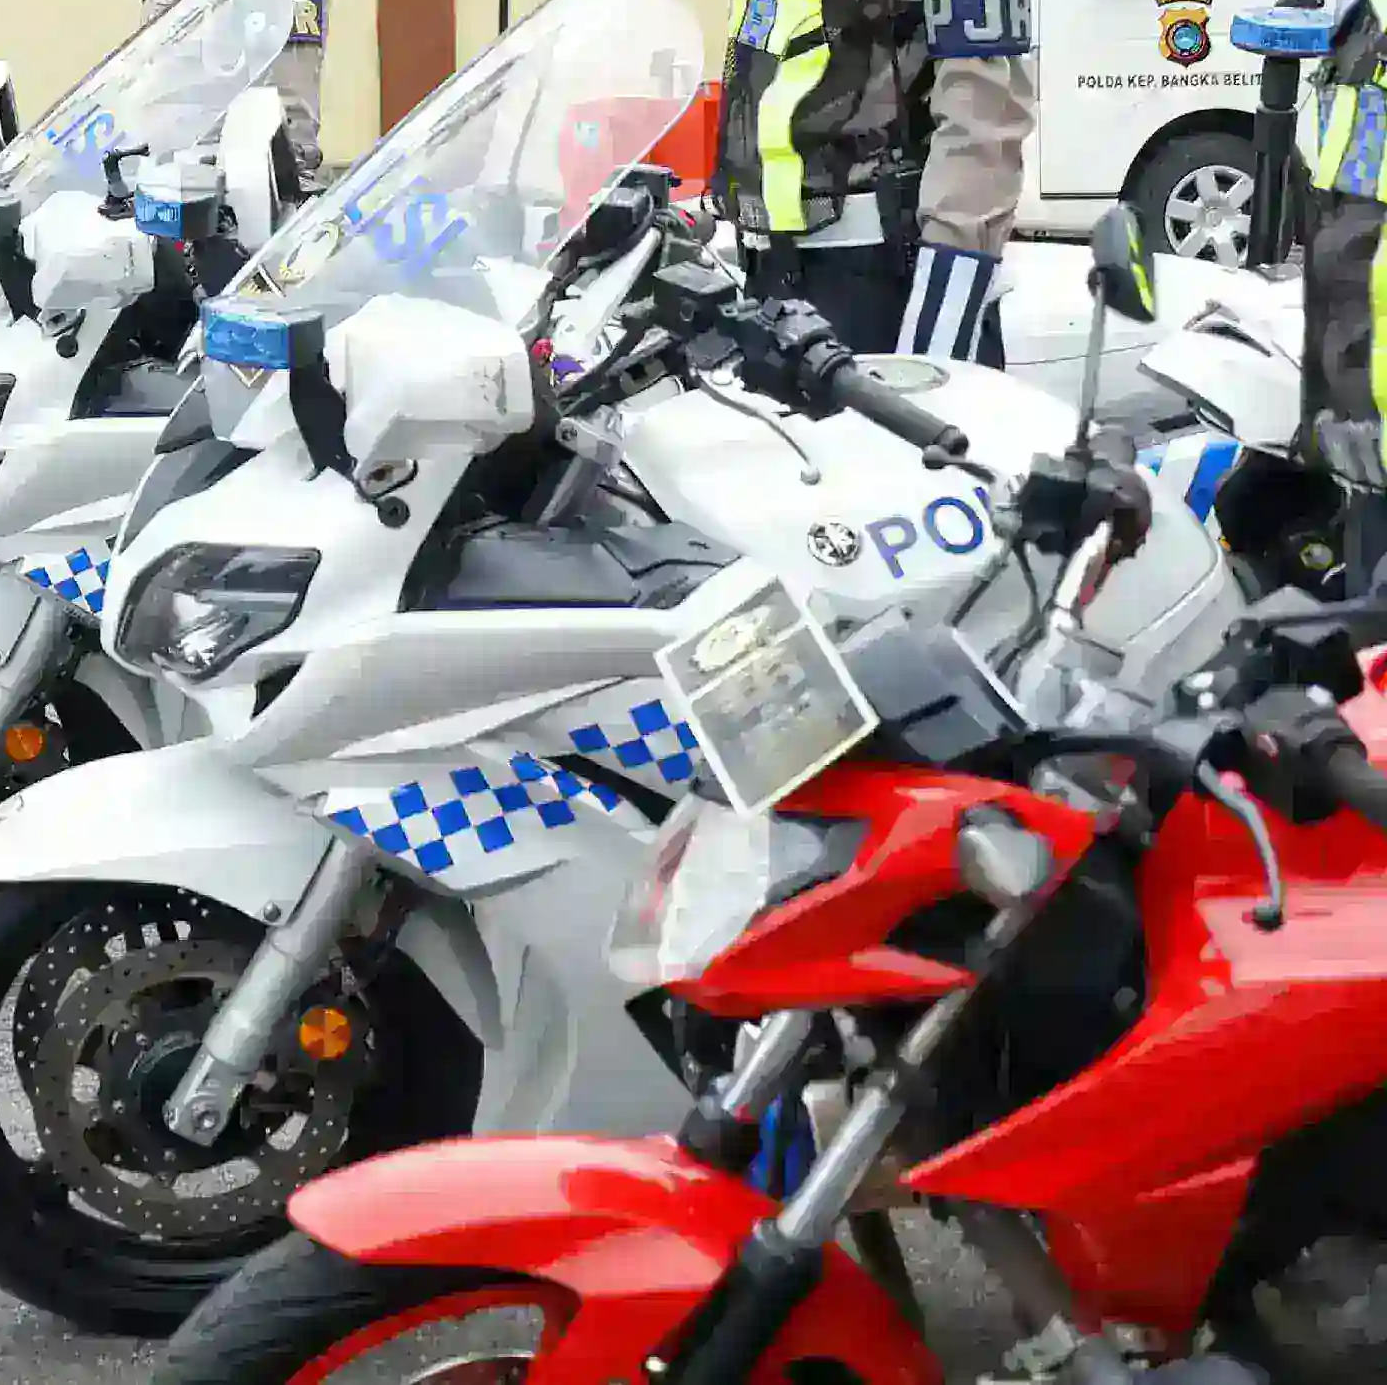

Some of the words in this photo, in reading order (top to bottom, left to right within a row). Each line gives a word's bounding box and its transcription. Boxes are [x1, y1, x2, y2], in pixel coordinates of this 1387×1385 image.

[1077, 74, 1124, 89] POLDA
[1161, 73, 1220, 89] BANGKA
[1223, 73, 1263, 87] BELIT
